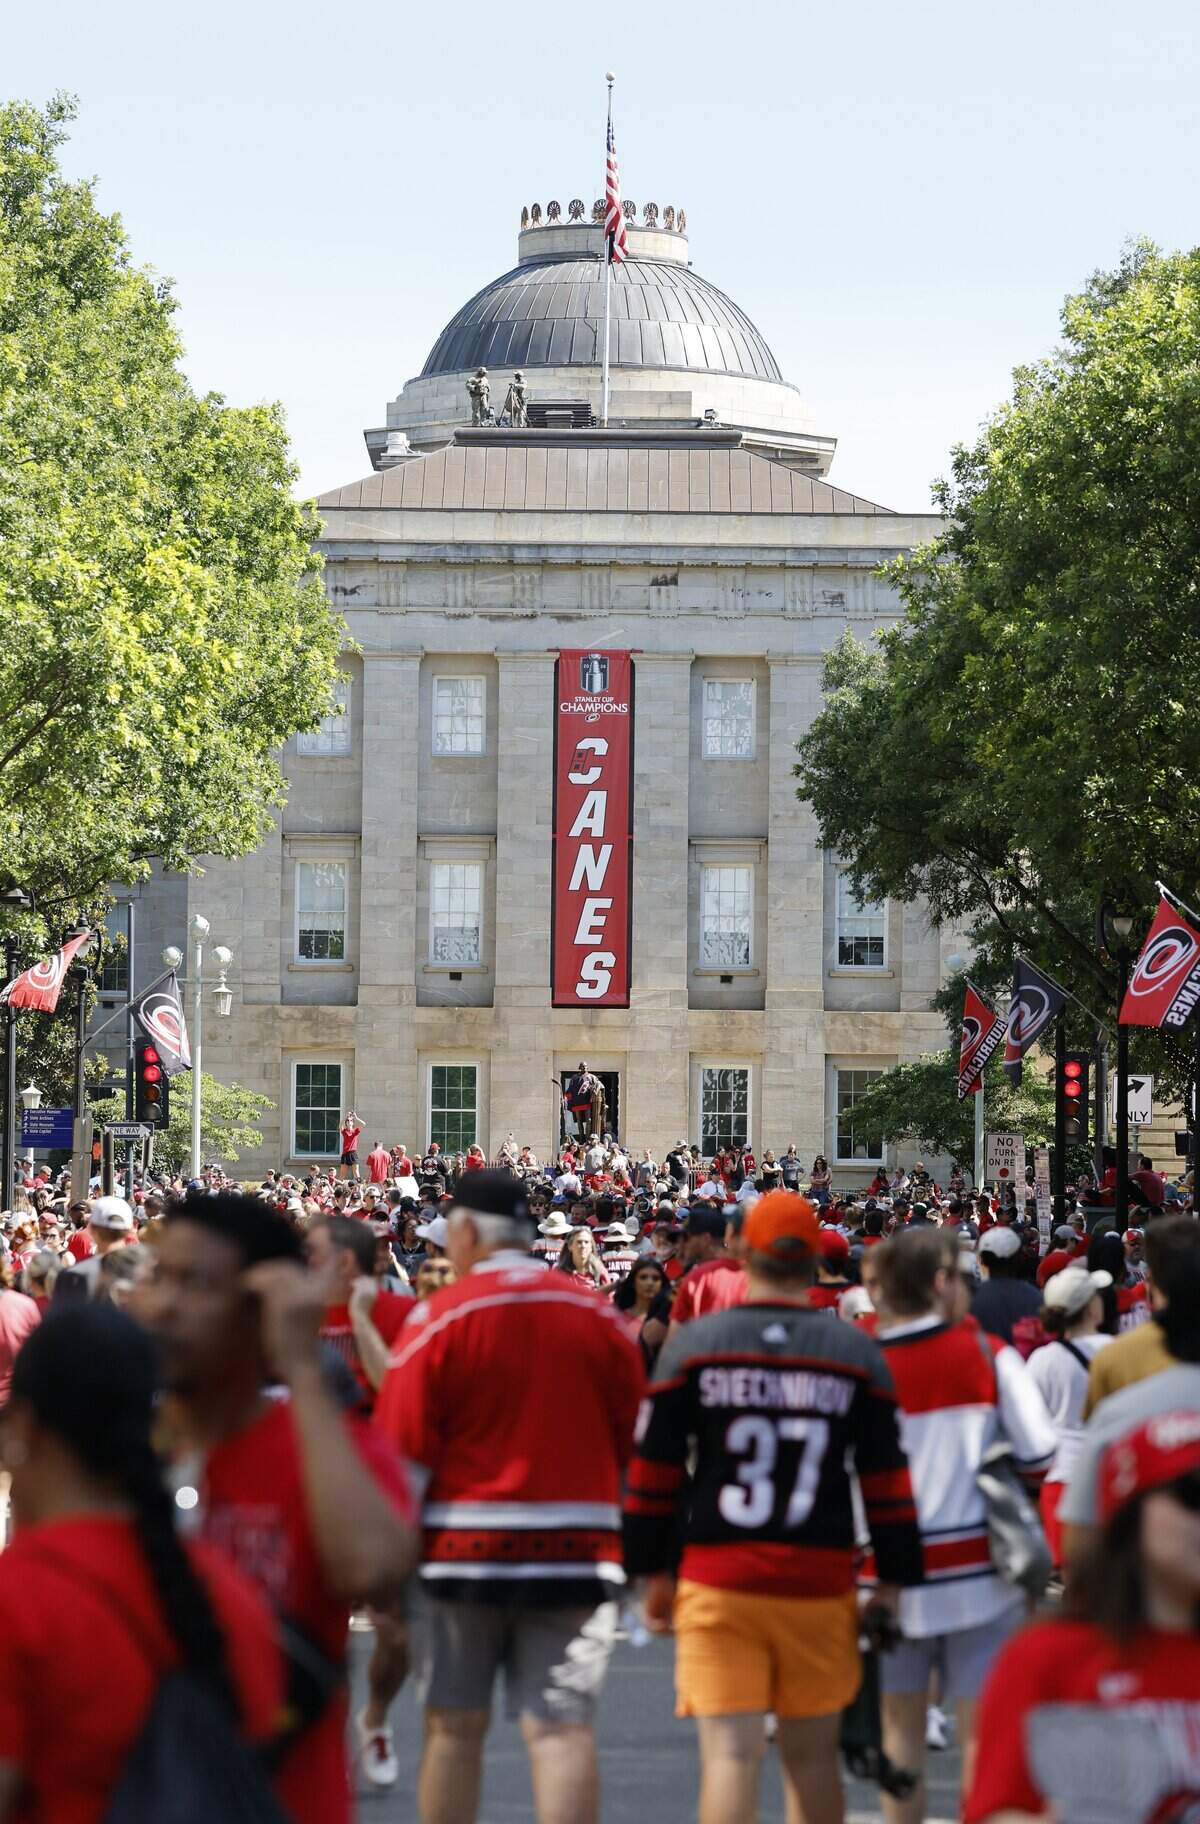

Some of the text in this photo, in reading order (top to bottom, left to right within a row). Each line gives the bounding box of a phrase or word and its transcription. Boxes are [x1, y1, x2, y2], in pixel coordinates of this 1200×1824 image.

[560, 702, 628, 713] CHAMPIONS
[568, 737, 617, 999] CANES
[1116, 1111, 1148, 1122] NLY
[997, 1137, 1014, 1147] NO
[994, 1148, 1016, 1156] TURN
[989, 1158, 1016, 1167] ON RE
[717, 1415, 829, 1528] 37
